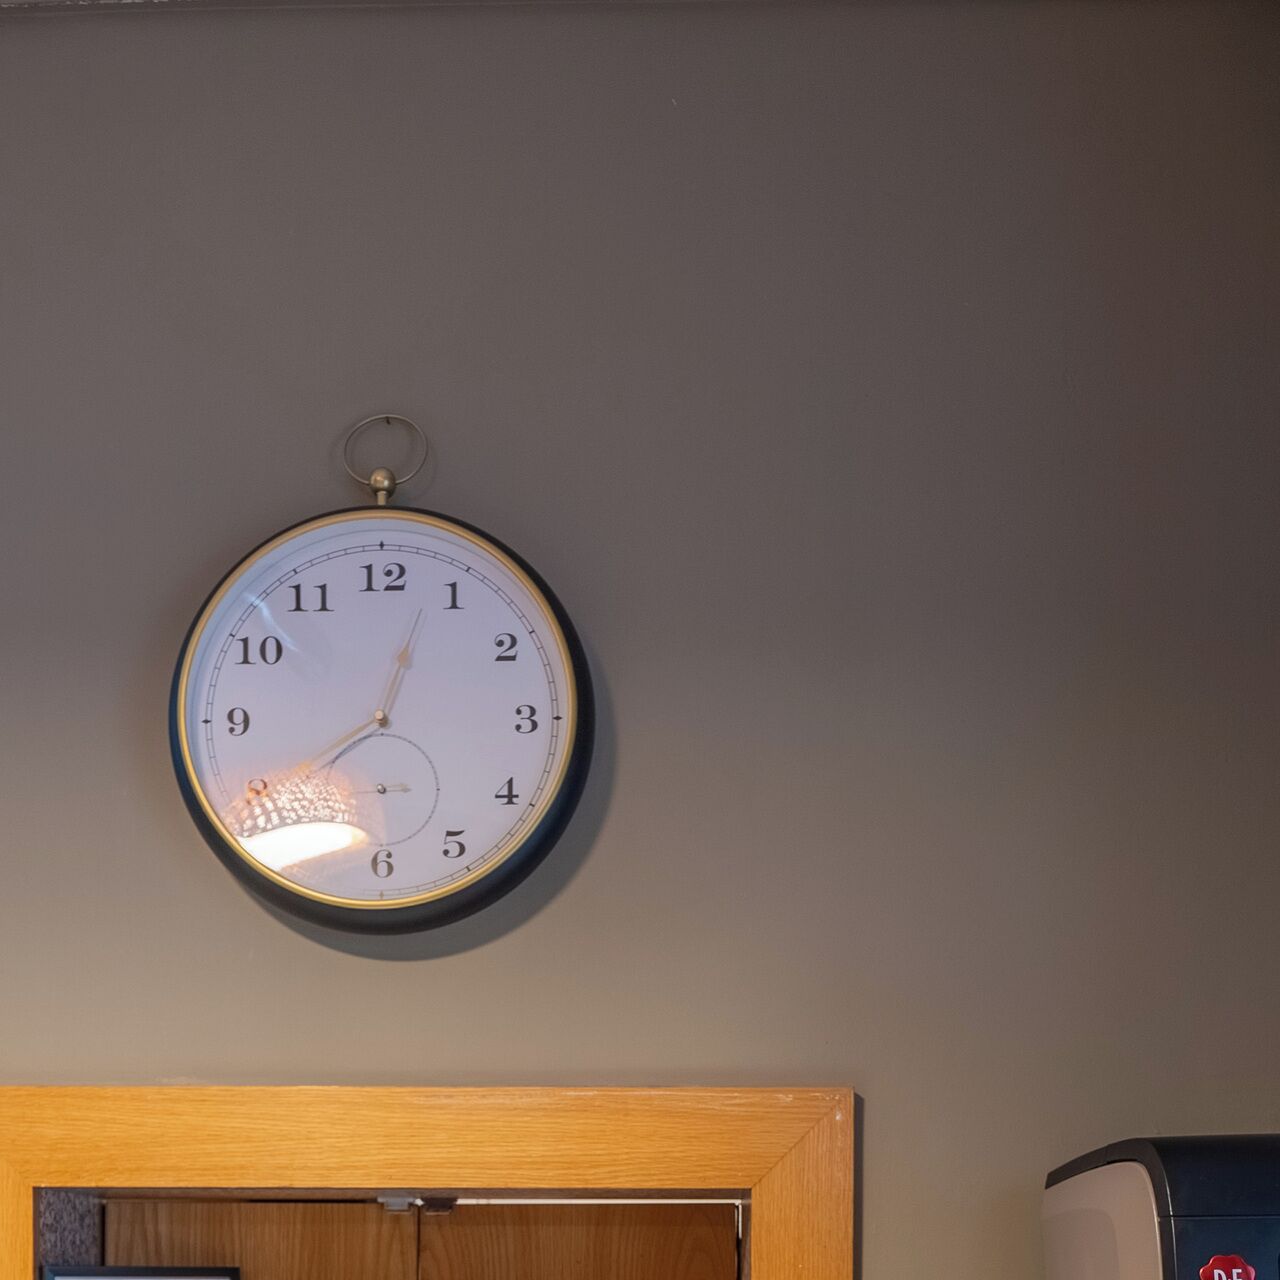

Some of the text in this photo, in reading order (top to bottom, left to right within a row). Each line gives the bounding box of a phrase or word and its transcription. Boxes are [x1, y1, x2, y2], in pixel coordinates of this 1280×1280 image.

[358, 563, 407, 592] 12
[287, 584, 334, 613] 11
[442, 581, 465, 610] 1
[234, 636, 283, 665] 10
[494, 633, 518, 662] 2
[226, 707, 250, 736] 9
[514, 704, 539, 734] 3
[246, 778, 268, 805] 8
[494, 777, 519, 805] 4
[442, 830, 466, 859] 5
[371, 849, 394, 878] 6
